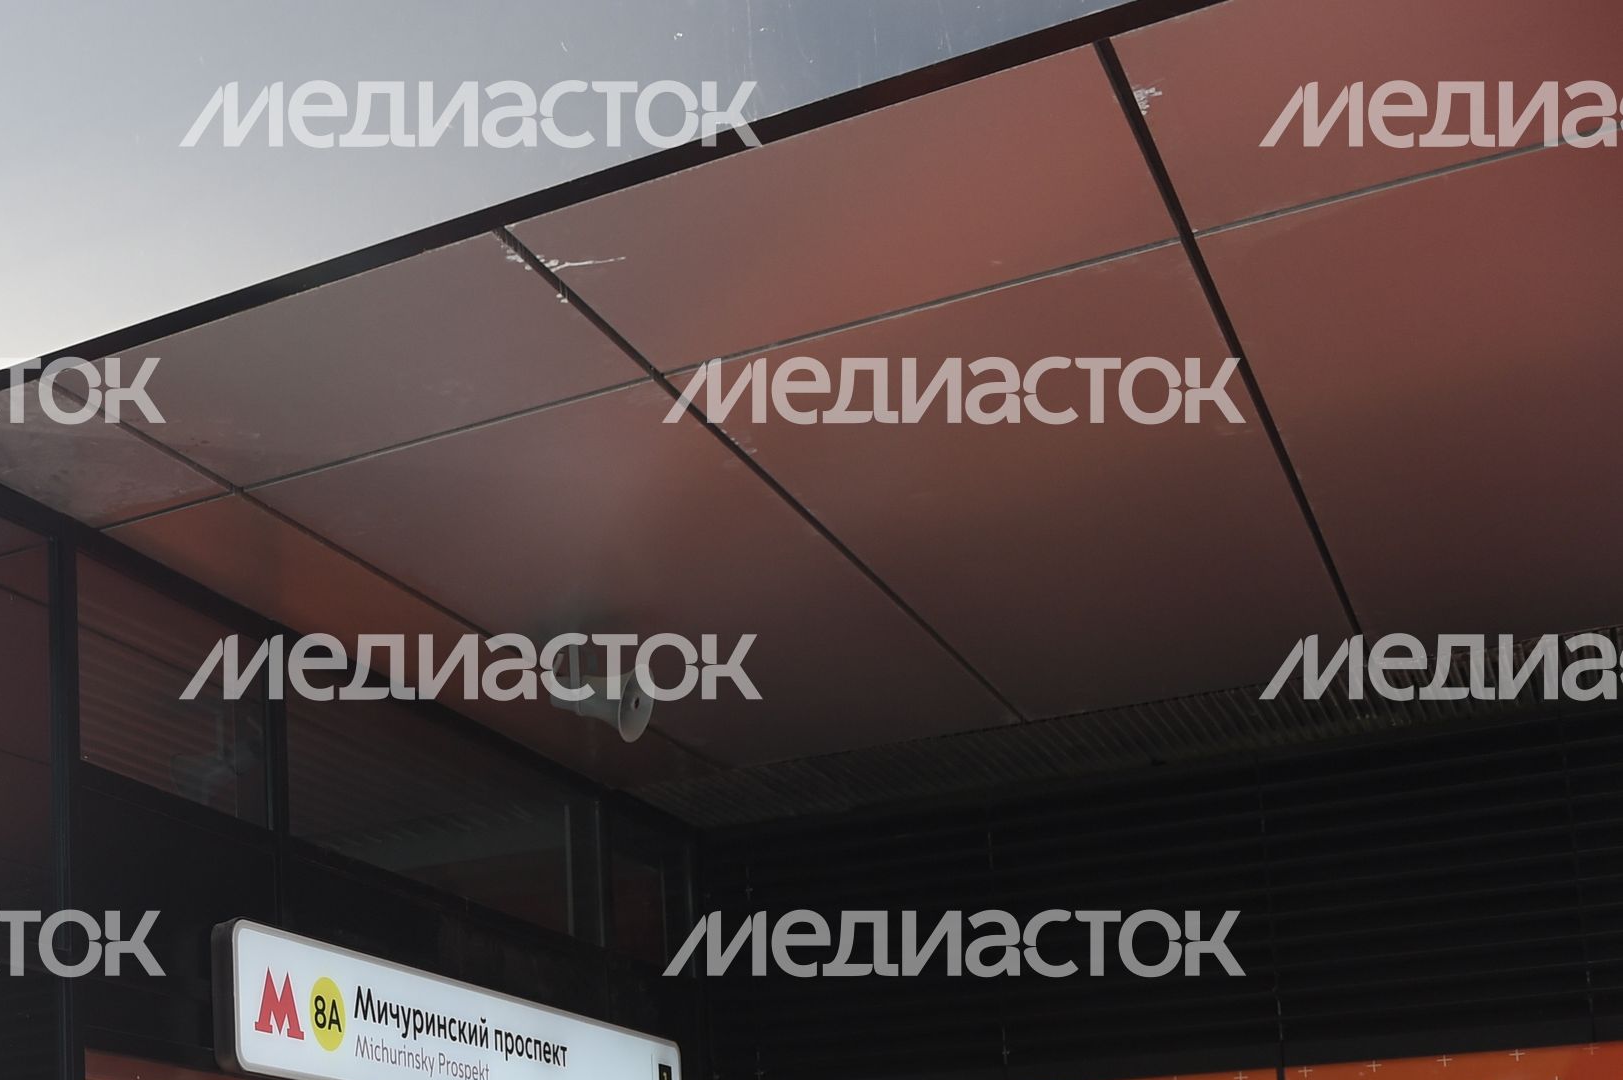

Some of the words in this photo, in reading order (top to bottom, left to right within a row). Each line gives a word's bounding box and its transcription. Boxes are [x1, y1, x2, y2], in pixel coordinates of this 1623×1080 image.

[354, 986, 489, 1049] Мичуринский
[494, 1029, 568, 1068] проспект
[354, 1035, 435, 1078] Michurinsky
